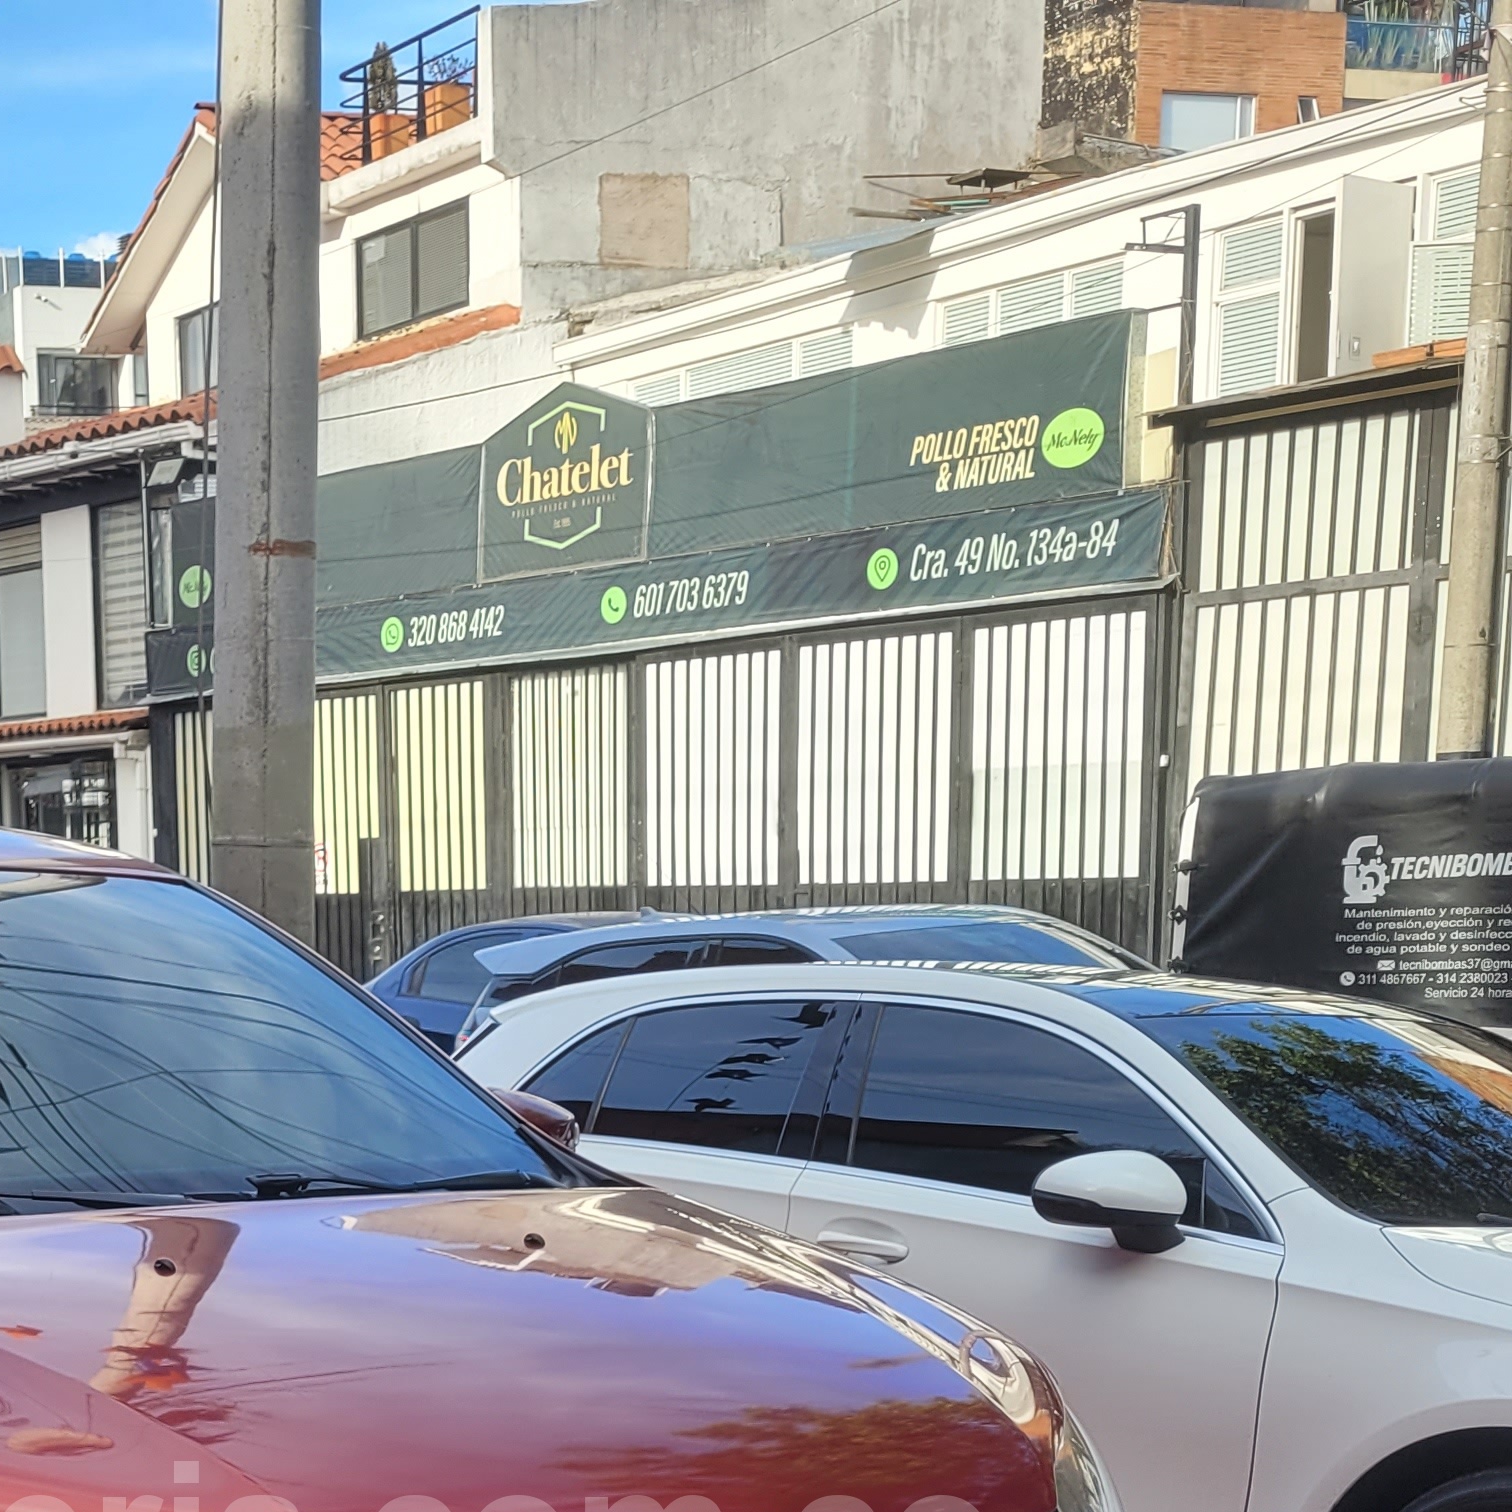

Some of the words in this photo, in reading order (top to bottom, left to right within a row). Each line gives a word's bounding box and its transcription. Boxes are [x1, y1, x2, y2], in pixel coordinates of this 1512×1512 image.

[909, 427, 968, 467] POLLO
[967, 414, 1040, 457] FRESCO
[496, 442, 635, 507] Chatelet
[935, 461, 952, 493] &
[953, 447, 1036, 491] NATURAL
[909, 542, 949, 582] Cra.
[954, 536, 985, 576] 49
[985, 532, 1019, 573] No.
[1026, 518, 1120, 567] 134a-84
[633, 581, 665, 619] 601
[665, 576, 701, 615] 703
[701, 569, 750, 610] 6379
[407, 613, 437, 648] 320
[437, 609, 468, 644] 868
[468, 604, 505, 640] 4142
[1343, 906, 1436, 919] Mantenimiento
[1439, 906, 1447, 918] y
[1356, 920, 1373, 931] de
[1487, 918, 1495, 929] y
[1346, 944, 1364, 955] de
[1365, 945, 1397, 956] agua
[1399, 942, 1447, 955] potable
[1450, 943, 1459, 955] y
[1461, 941, 1511, 952] sondeo
[1393, 930, 1436, 942] lavado
[1439, 931, 1447, 943] y
[1357, 973, 1377, 985] 311
[1436, 972, 1457, 984] 314
[1424, 987, 1468, 999] Servicio
[1470, 987, 1485, 998] 24
